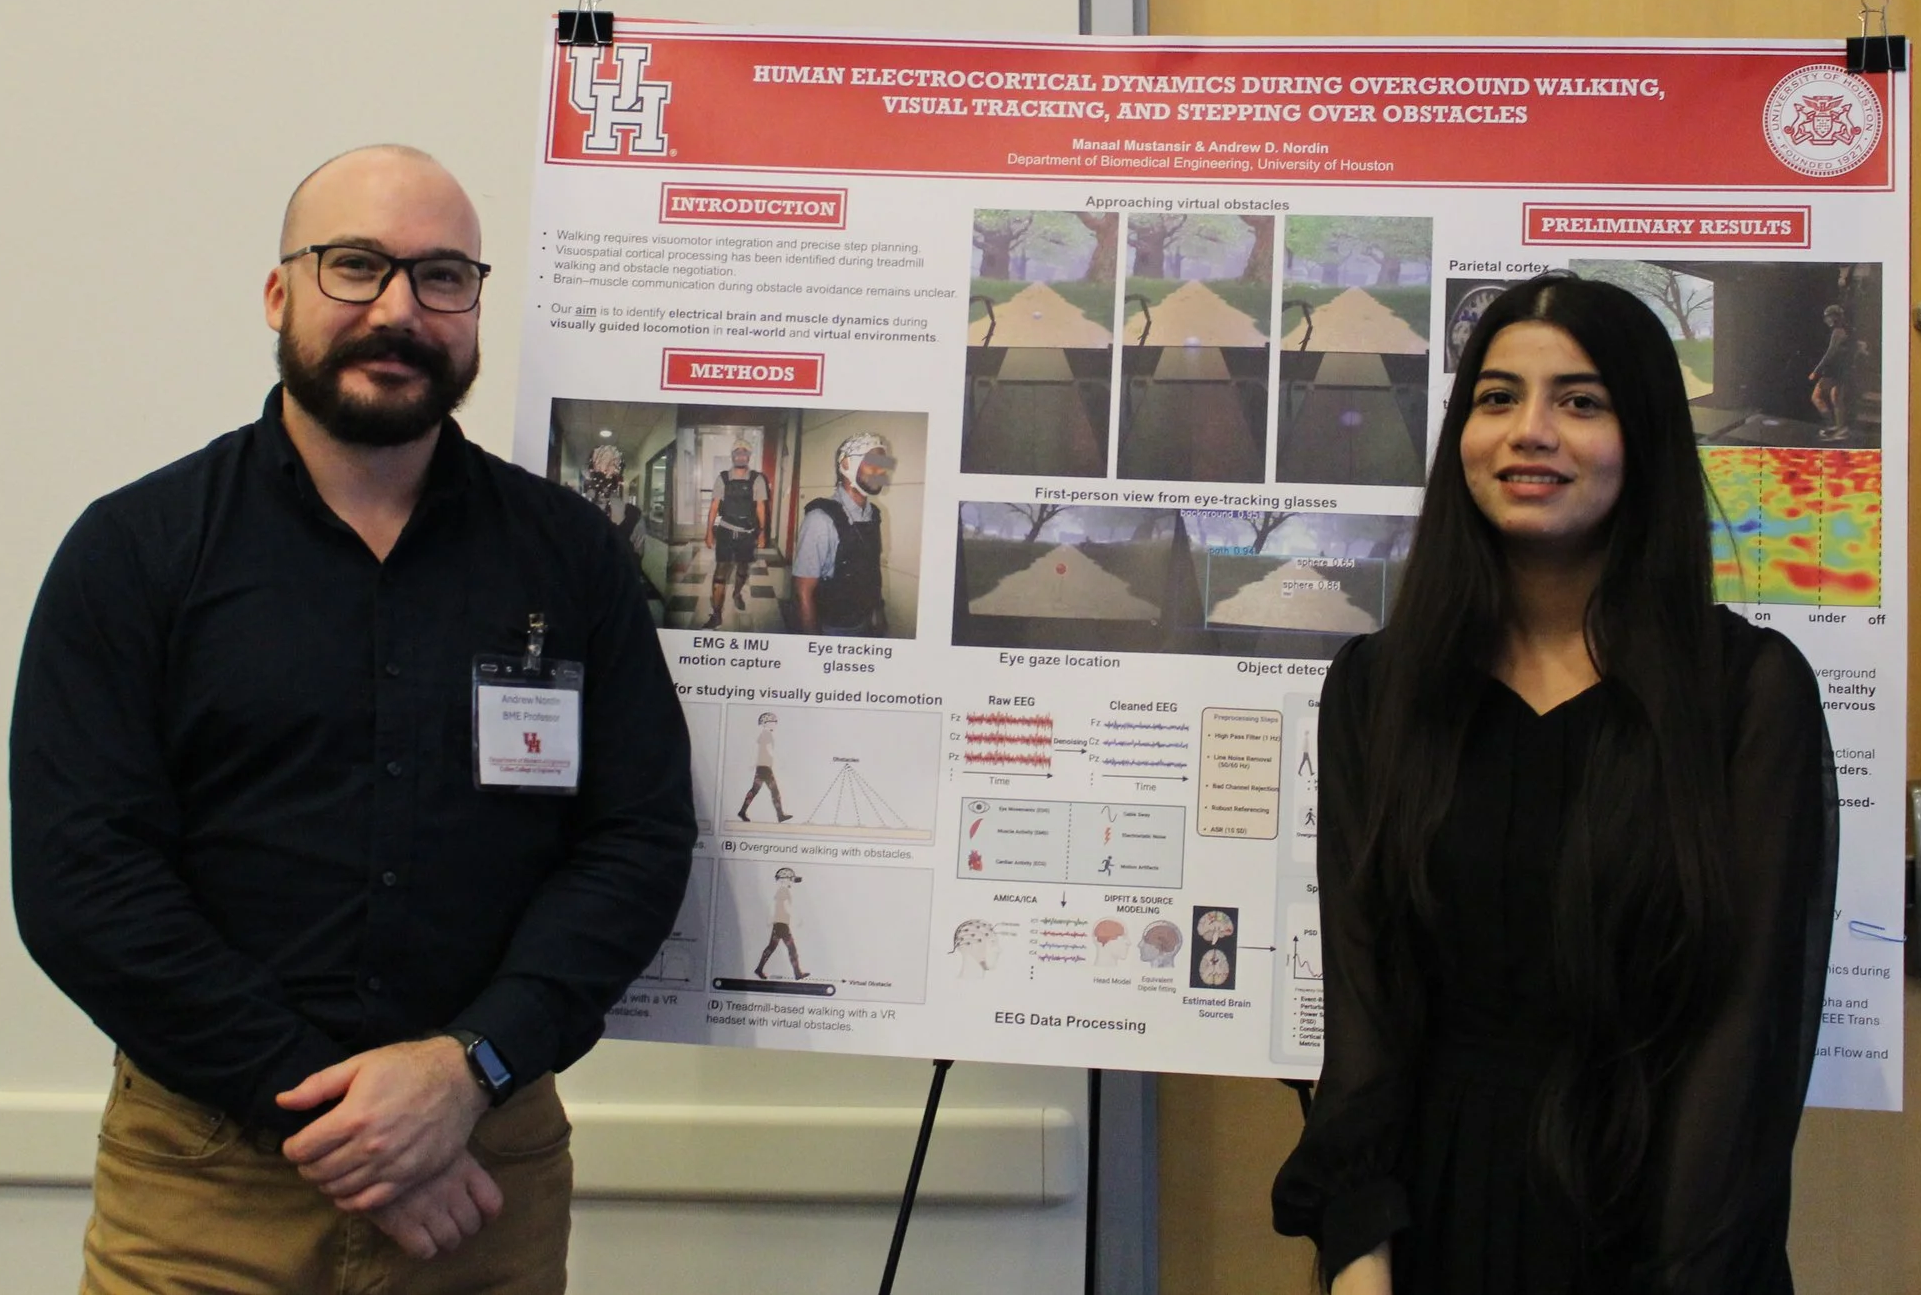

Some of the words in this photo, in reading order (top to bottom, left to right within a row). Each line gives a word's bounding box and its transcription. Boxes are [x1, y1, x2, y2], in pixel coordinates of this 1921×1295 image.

[753, 65, 846, 85] HUMAN
[850, 68, 1096, 91] ELECTROCORTICAL
[1101, 75, 1236, 94] DYNAMICS
[1242, 76, 1343, 95] DURING
[1349, 77, 1530, 96] OVERGROUND
[1534, 78, 1666, 101] WALKING,
[882, 95, 968, 116] VISUAL
[972, 98, 1111, 122] TRACKING,
[1117, 102, 1170, 120] AND
[1176, 103, 1301, 122] STEPPING
[1308, 105, 1377, 123] OVER
[1382, 105, 1528, 124] OBSTACLES
[1772, 72, 1819, 131] UNIVERSITY
[1822, 72, 1841, 81] OF
[1843, 78, 1874, 132] HOUSTON
[1072, 138, 1121, 151] Manaal
[1124, 140, 1191, 152] Mustansir
[1195, 141, 1206, 153] &
[1208, 141, 1261, 153] Andrew
[1265, 142, 1279, 153] D.
[1283, 141, 1329, 154] Nordin
[1007, 153, 1082, 169] Department
[1084, 155, 1097, 167] of
[1100, 155, 1170, 168] Biomedical
[1173, 156, 1255, 171] Engineering,
[1257, 158, 1320, 172] University
[1324, 158, 1337, 170] of
[1340, 158, 1394, 171] Houston
[1780, 144, 1832, 169] FOUNDED
[1838, 145, 1862, 165] 1927
[671, 196, 836, 217] INTRODUCTION
[1085, 196, 1173, 211] Approaching
[1177, 197, 1220, 209] virtual
[1224, 198, 1290, 211] obstacles
[1541, 217, 1694, 235] PRELIMINARY
[1699, 219, 1792, 235] RESULTS
[556, 230, 600, 244] Walking
[604, 233, 648, 245] requires
[652, 236, 711, 246] visuomotor
[715, 236, 773, 248] integration
[776, 239, 797, 249] and
[801, 240, 840, 251] precise
[844, 241, 868, 252] step
[871, 243, 921, 254] planning.
[556, 245, 622, 258] Visuospatial
[625, 248, 664, 259] cortical
[668, 250, 728, 263] processing
[731, 252, 751, 262] has
[754, 254, 782, 263] been
[785, 254, 835, 265] identified
[838, 256, 873, 268] during
[877, 258, 924, 268] treadmill
[1449, 260, 1502, 272] Parietal
[1506, 262, 1550, 273] cortex
[632, 279, 715, 290] communication
[718, 281, 753, 293] during
[756, 283, 802, 293] obstacle
[806, 284, 863, 296] avoidance
[866, 286, 910, 297] remains
[914, 287, 958, 298] unclear.
[551, 303, 572, 314] Our
[575, 304, 597, 316] aim
[600, 306, 609, 316] is
[612, 306, 623, 316] to
[626, 306, 666, 320] identify
[668, 308, 723, 320] electrical
[726, 310, 756, 321] brain
[760, 312, 782, 322] and
[785, 313, 829, 324] muscle
[832, 315, 889, 327] dynamics
[892, 316, 928, 329] during
[550, 318, 596, 332] visually
[599, 320, 640, 333] guided
[643, 323, 710, 335] locomotion
[713, 325, 723, 335] in
[726, 326, 786, 337] real-world
[789, 329, 810, 338] and
[813, 329, 851, 339] virtual
[854, 331, 940, 343] environments.
[690, 363, 795, 381] METHODS
[1035, 487, 1119, 503] First-person
[1123, 490, 1154, 502] view
[1158, 491, 1190, 503] from
[1194, 492, 1280, 508] eye-tracking
[1284, 496, 1337, 510] glasses
[1181, 509, 1233, 519] background
[1297, 558, 1327, 568] sphere
[1283, 581, 1313, 591] sphere
[1755, 612, 1771, 620] on
[1809, 613, 1847, 623] under
[1868, 614, 1885, 625] off
[693, 636, 726, 650] EMG
[730, 638, 740, 650] &
[744, 638, 769, 651] IMU
[808, 642, 832, 658] Eye
[837, 644, 893, 659] tracking
[678, 654, 727, 668] motion
[730, 656, 781, 671] capture
[823, 660, 875, 674] glasses
[1000, 652, 1024, 666] Eye
[1029, 655, 1061, 668] gaze
[1065, 655, 1121, 668] location
[1237, 661, 1283, 676] Object
[1815, 668, 1876, 680] verground
[696, 684, 754, 700] studying
[759, 686, 811, 703] visually
[815, 688, 862, 703] guided
[866, 691, 943, 705] locomotion
[1828, 684, 1876, 698] healthy
[988, 695, 1011, 706] Raw
[1014, 696, 1035, 707] EEG
[1109, 700, 1153, 712] Cleaned
[1156, 702, 1178, 713] EEG
[1214, 713, 1259, 723] Preprocessing
[1053, 737, 1088, 746] Denoising
[989, 777, 1010, 786] Time
[1134, 782, 1156, 792] Time
[721, 841, 736, 852] (B)
[739, 842, 798, 855] Overground
[800, 846, 838, 857] walking
[841, 847, 861, 857] with
[864, 849, 914, 860] obstacles.
[1852, 965, 1890, 979] during
[1182, 996, 1226, 1008] Estimated
[1228, 998, 1251, 1008] Brain
[1846, 999, 1868, 1009] and
[1198, 1009, 1234, 1019] Sources
[1848, 1014, 1880, 1026] Trans
[994, 1012, 1025, 1025] EEG
[1030, 1013, 1062, 1028] Data
[1066, 1016, 1146, 1034] Processing
[1834, 1047, 1863, 1058] Flow
[1865, 1049, 1889, 1060] and
